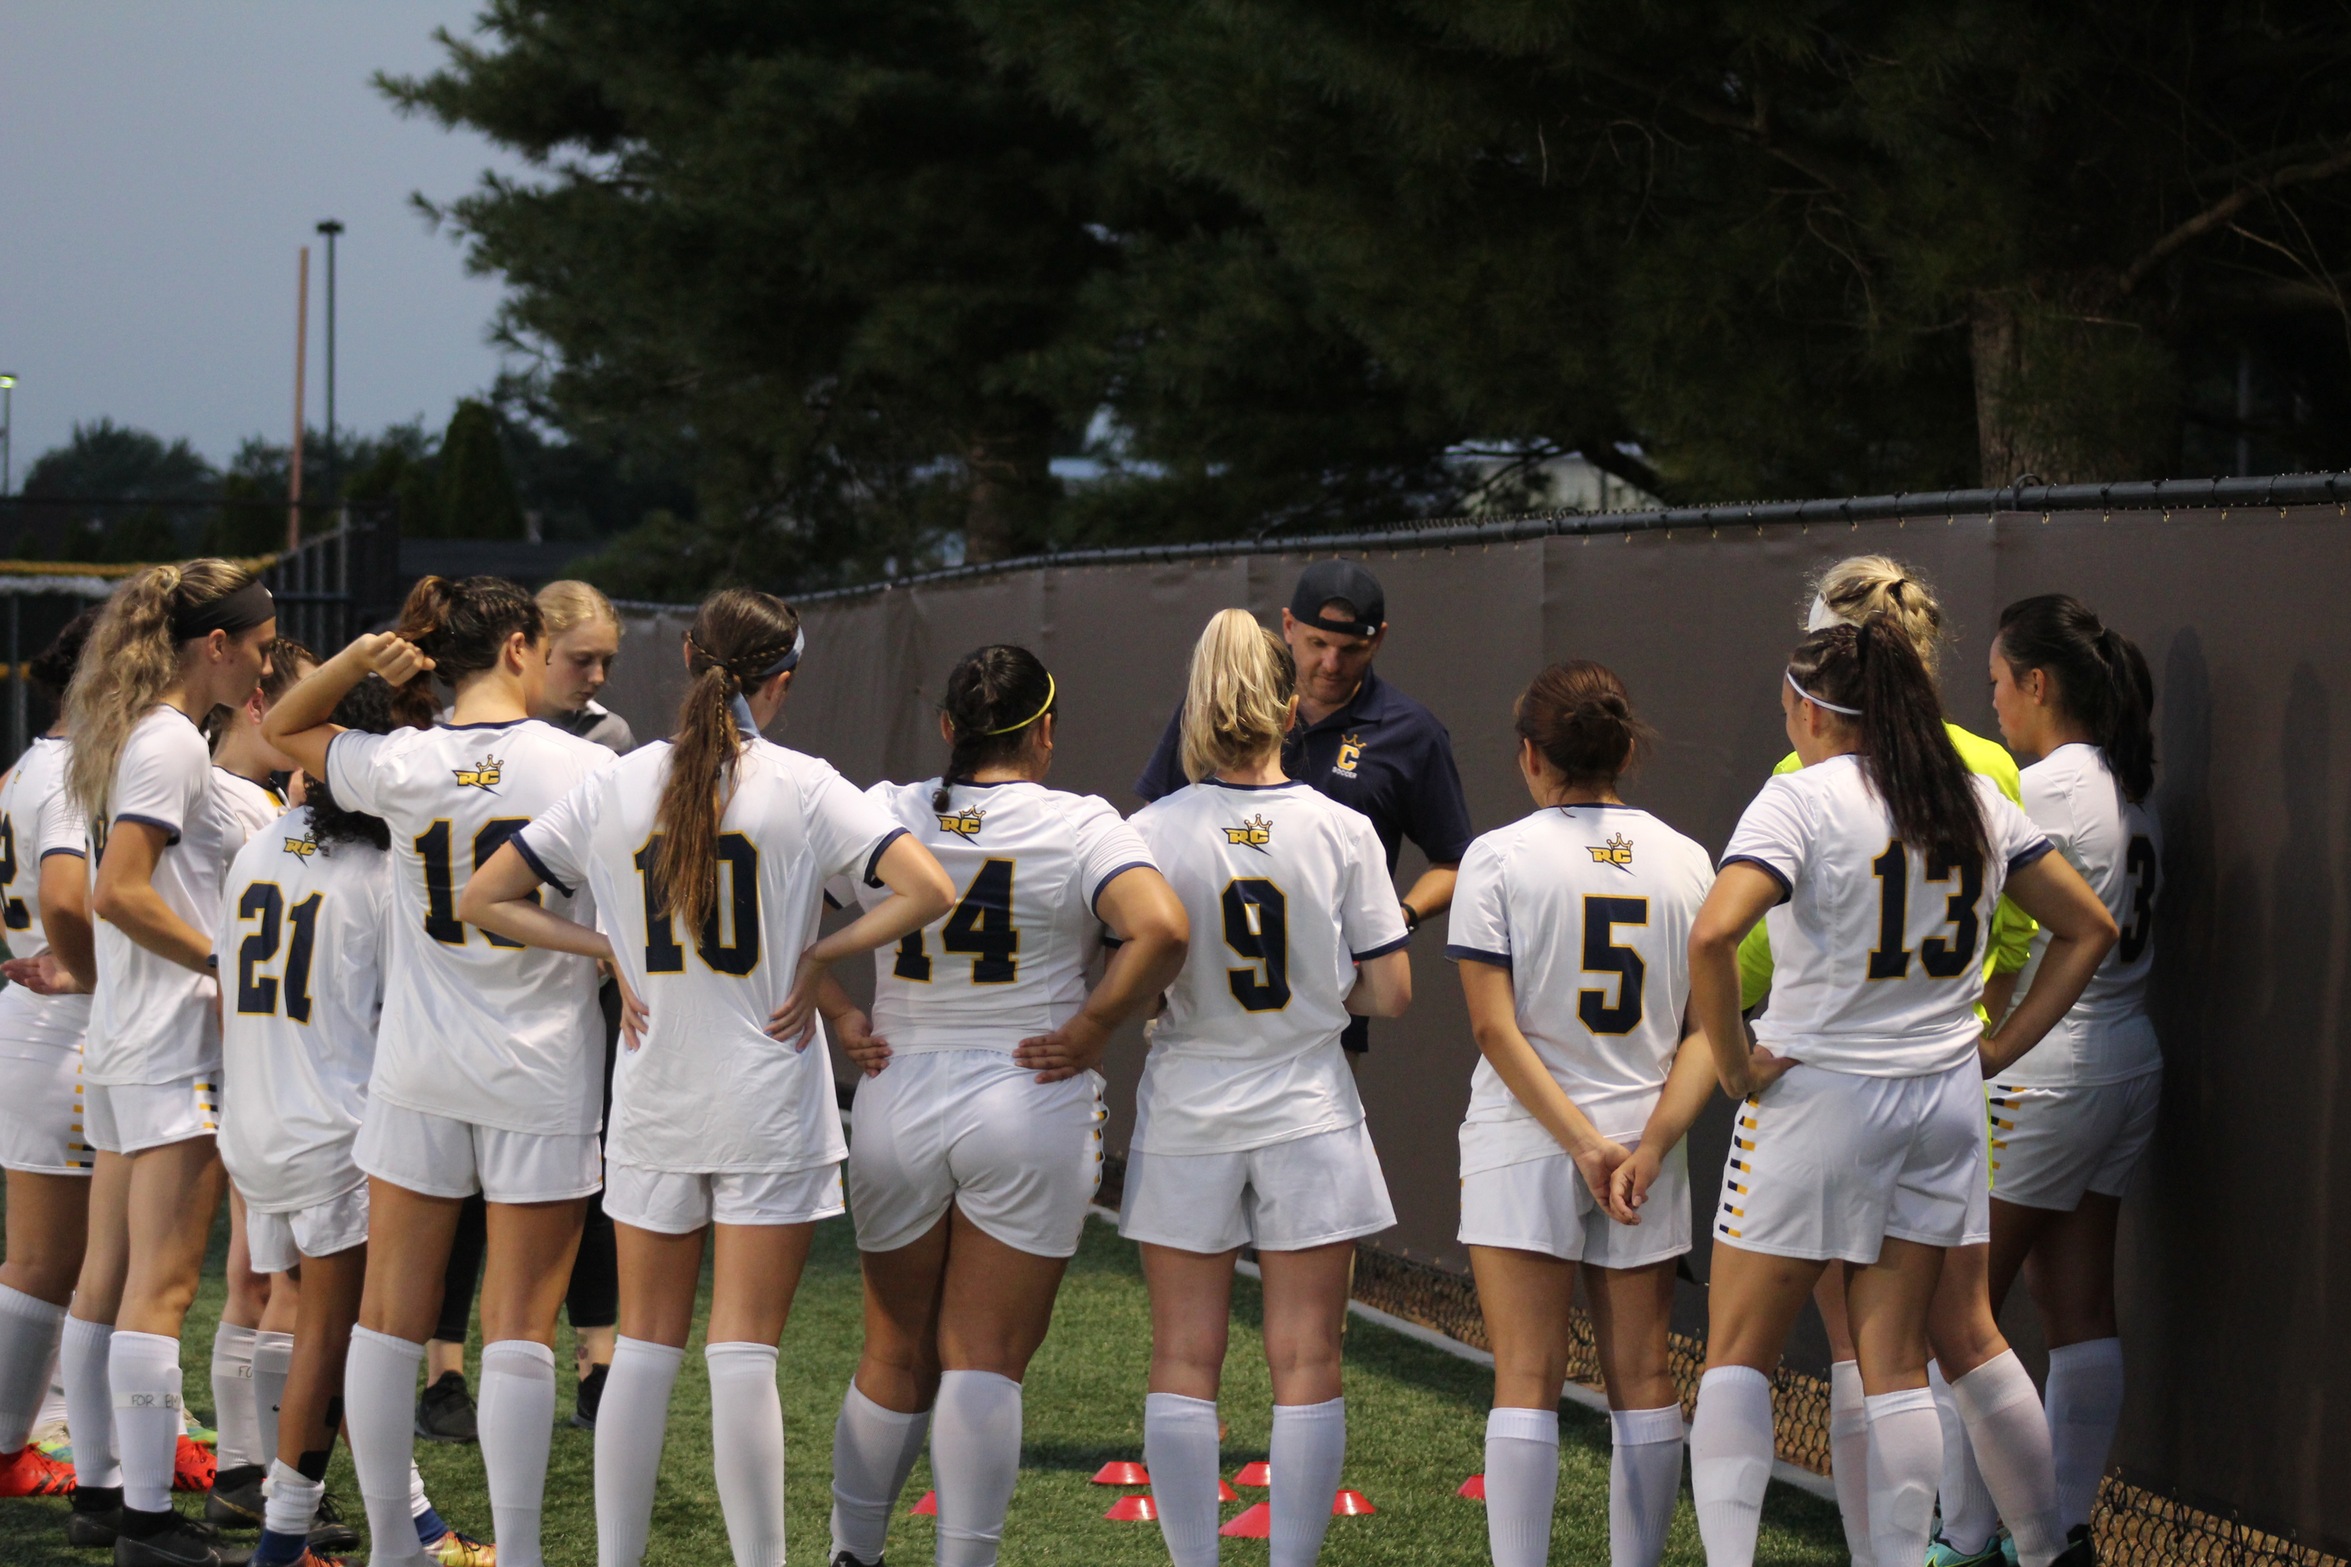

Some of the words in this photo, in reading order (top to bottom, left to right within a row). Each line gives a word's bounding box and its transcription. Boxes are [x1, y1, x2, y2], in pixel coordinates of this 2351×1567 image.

[1332, 766, 1358, 779] SOCCER
[1337, 744, 1360, 771] C
[451, 769, 503, 798] RC
[935, 814, 981, 847] RC
[1221, 827, 1273, 858] RC
[283, 836, 318, 869] RC
[1584, 846, 1637, 878] RC
[632, 829, 762, 979] 10
[1866, 837, 1984, 980] 13
[2119, 833, 2156, 963] 3
[237, 880, 323, 1026] 21
[1220, 876, 1292, 1014] 9
[1576, 893, 1650, 1037] 5
[131, 1394, 156, 1407] FOR
